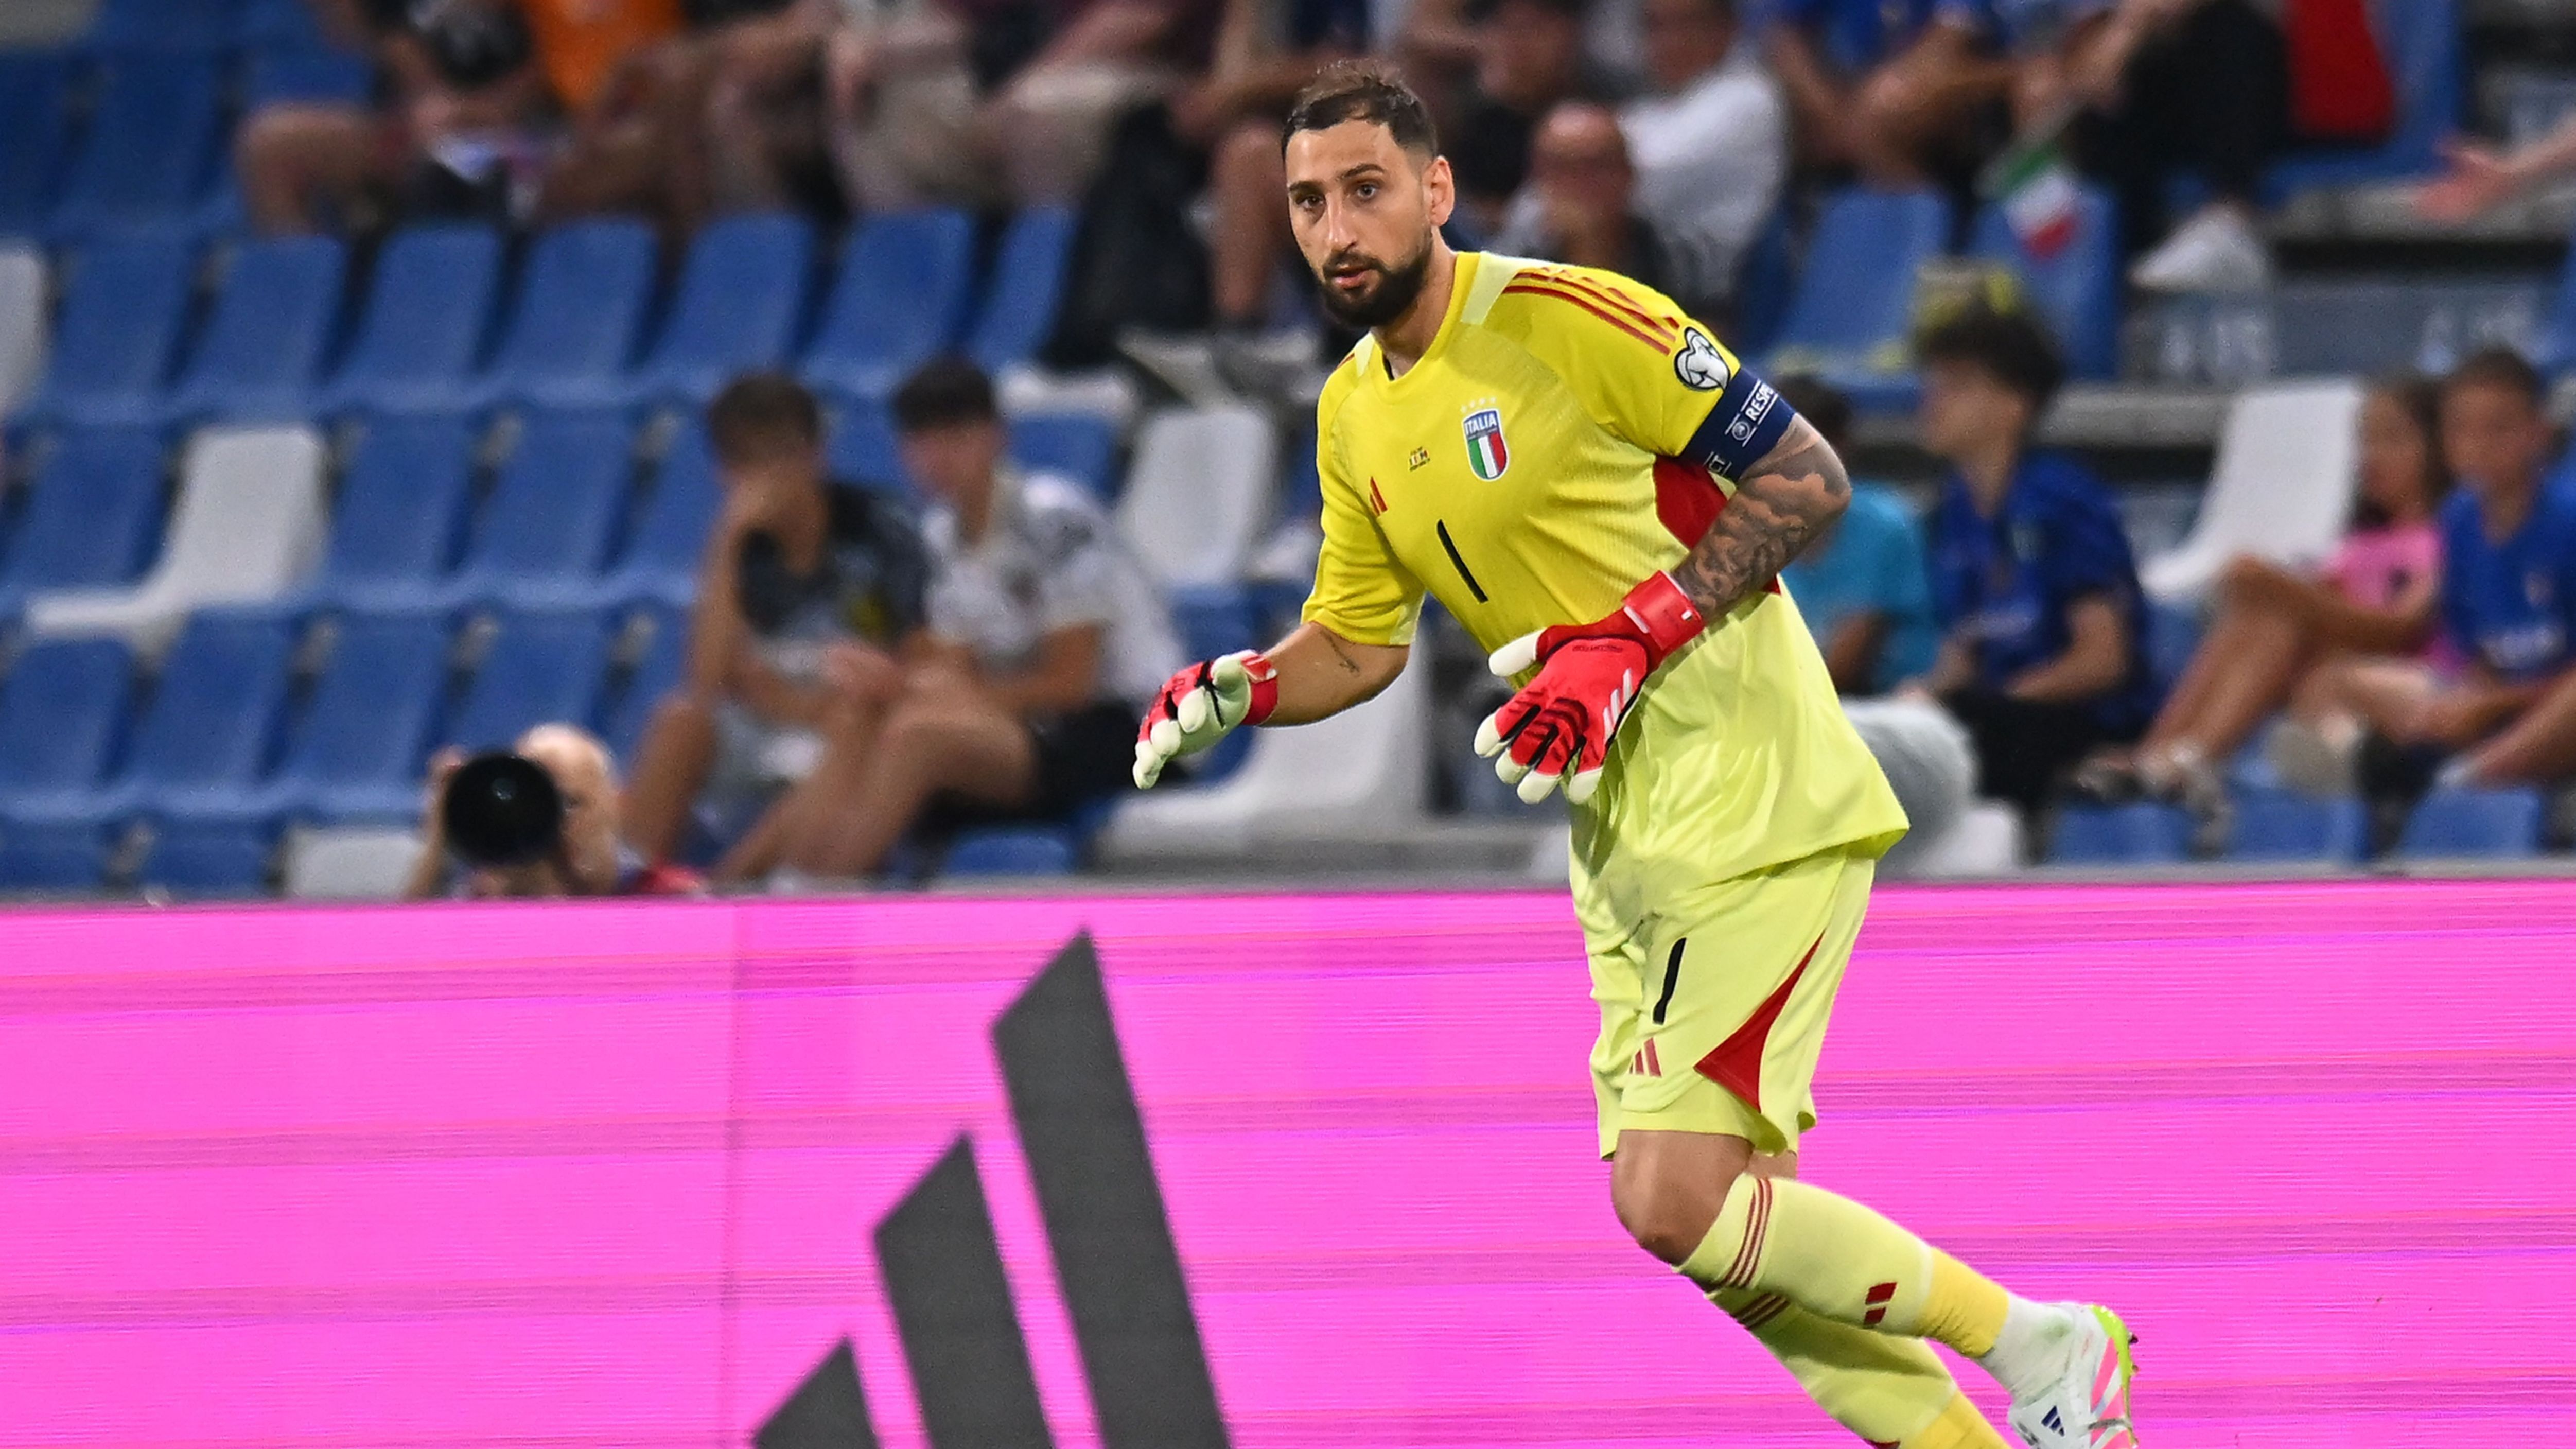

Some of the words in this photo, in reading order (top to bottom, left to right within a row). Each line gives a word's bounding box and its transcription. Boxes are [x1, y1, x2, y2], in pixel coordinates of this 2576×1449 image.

[1464, 413, 1497, 435] ITALIA
[1436, 518, 1489, 603] 1
[1652, 937, 1687, 1025] 1
